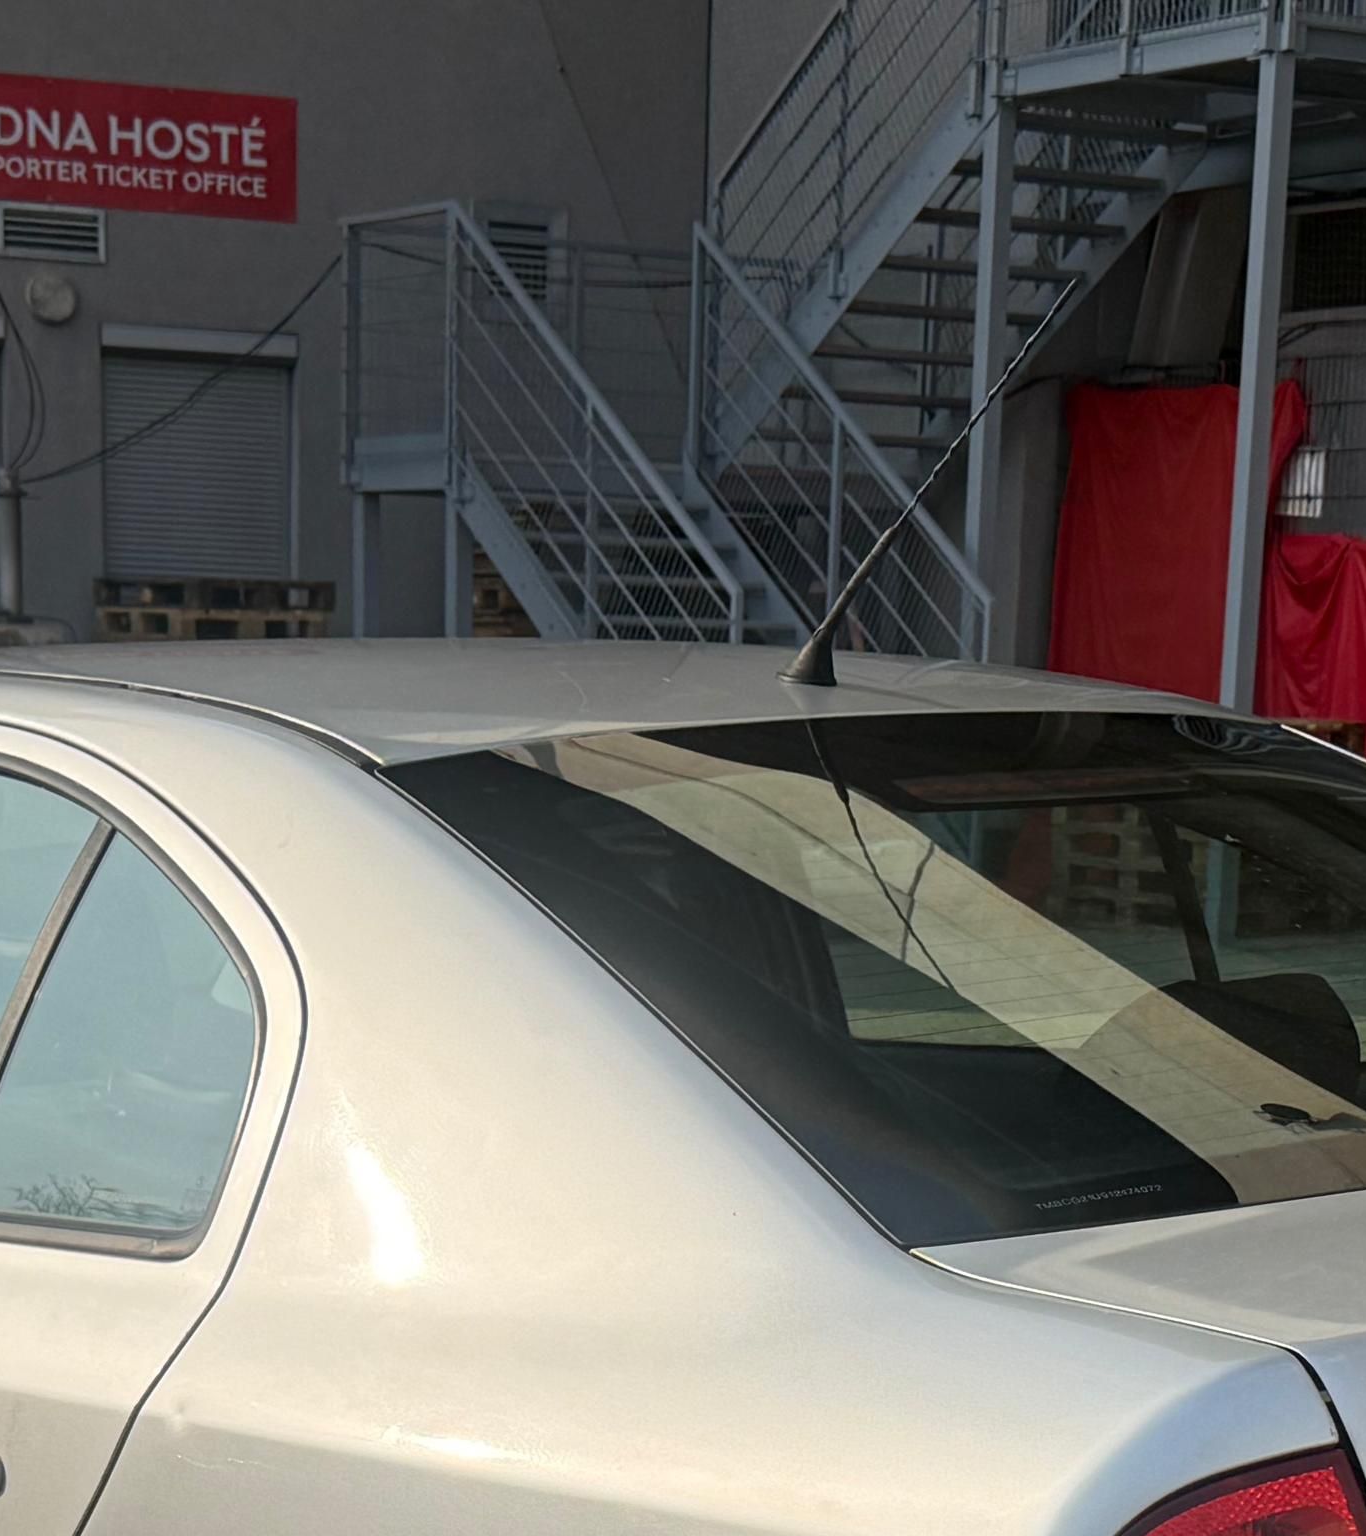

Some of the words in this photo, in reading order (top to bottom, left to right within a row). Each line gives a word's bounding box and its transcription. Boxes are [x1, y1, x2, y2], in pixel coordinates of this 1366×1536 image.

[107, 116, 268, 168] HOSTÉ
[92, 163, 177, 192] TICKET
[182, 171, 268, 198] OFFICE
